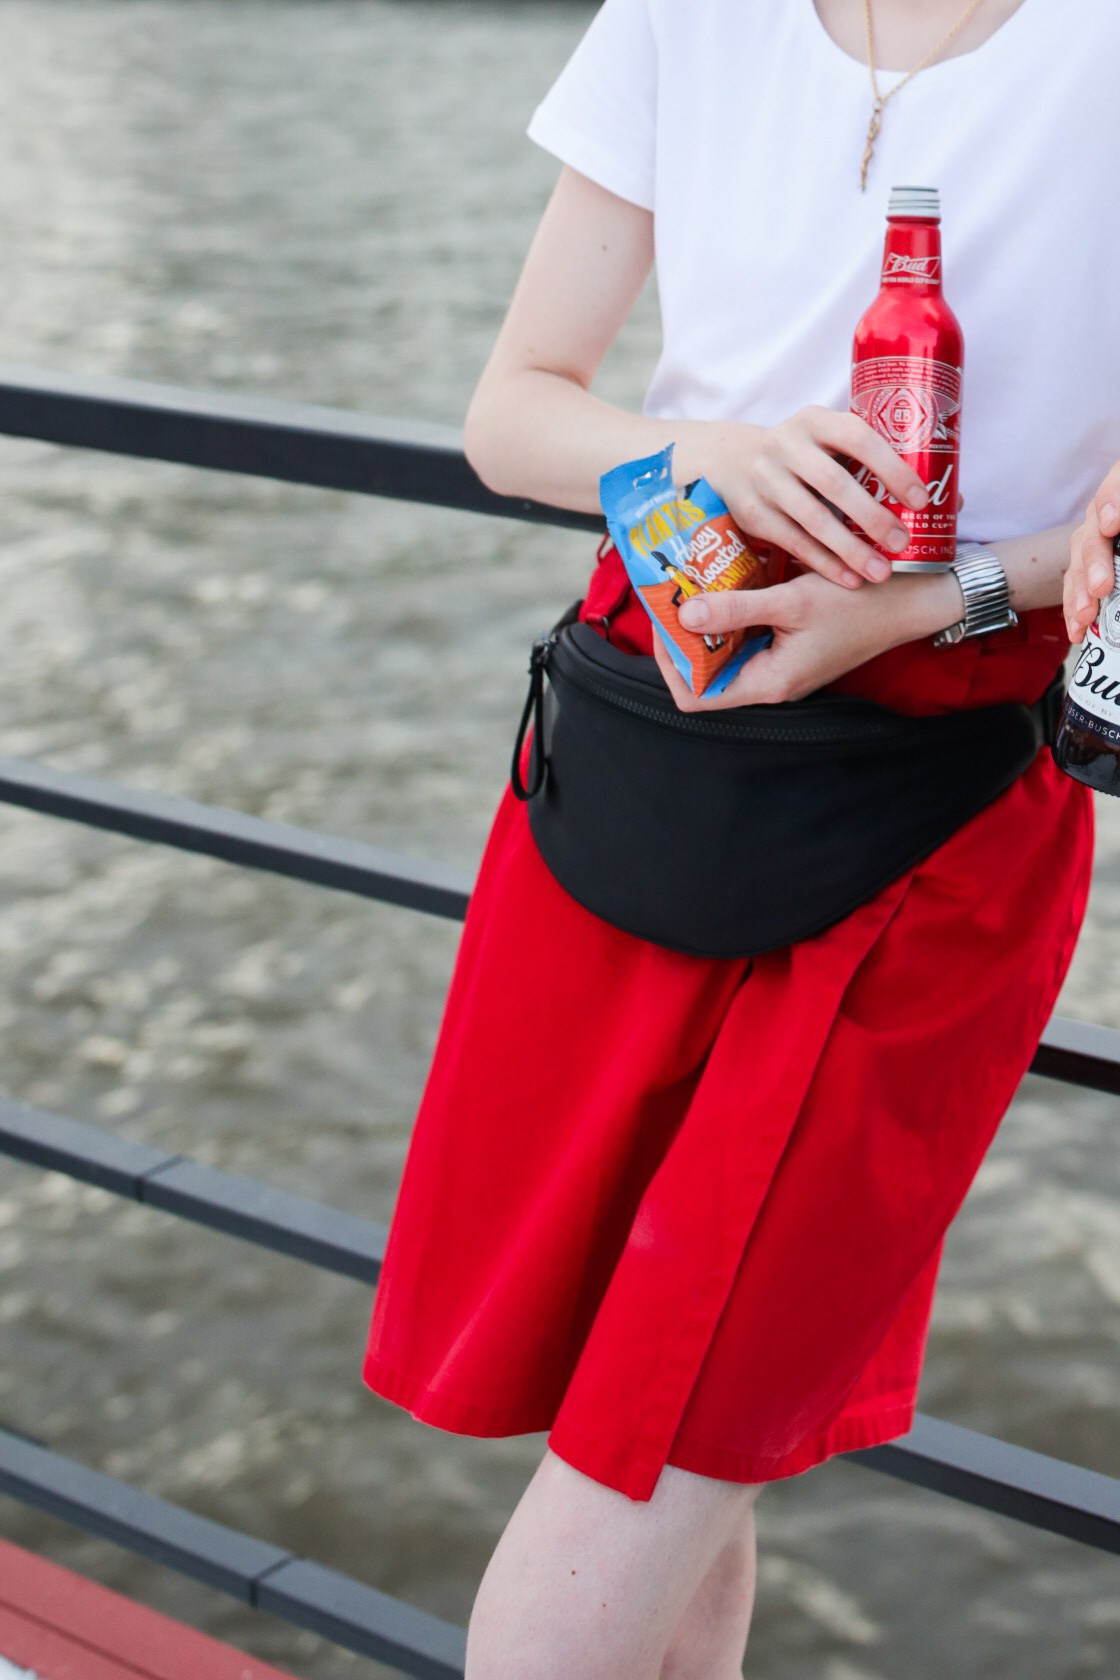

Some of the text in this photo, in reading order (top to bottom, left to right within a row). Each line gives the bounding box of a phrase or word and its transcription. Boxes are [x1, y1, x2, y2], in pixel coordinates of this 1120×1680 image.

[890, 255, 930, 272] Bud
[668, 525, 723, 567] Honey
[683, 529, 746, 593] Roasted
